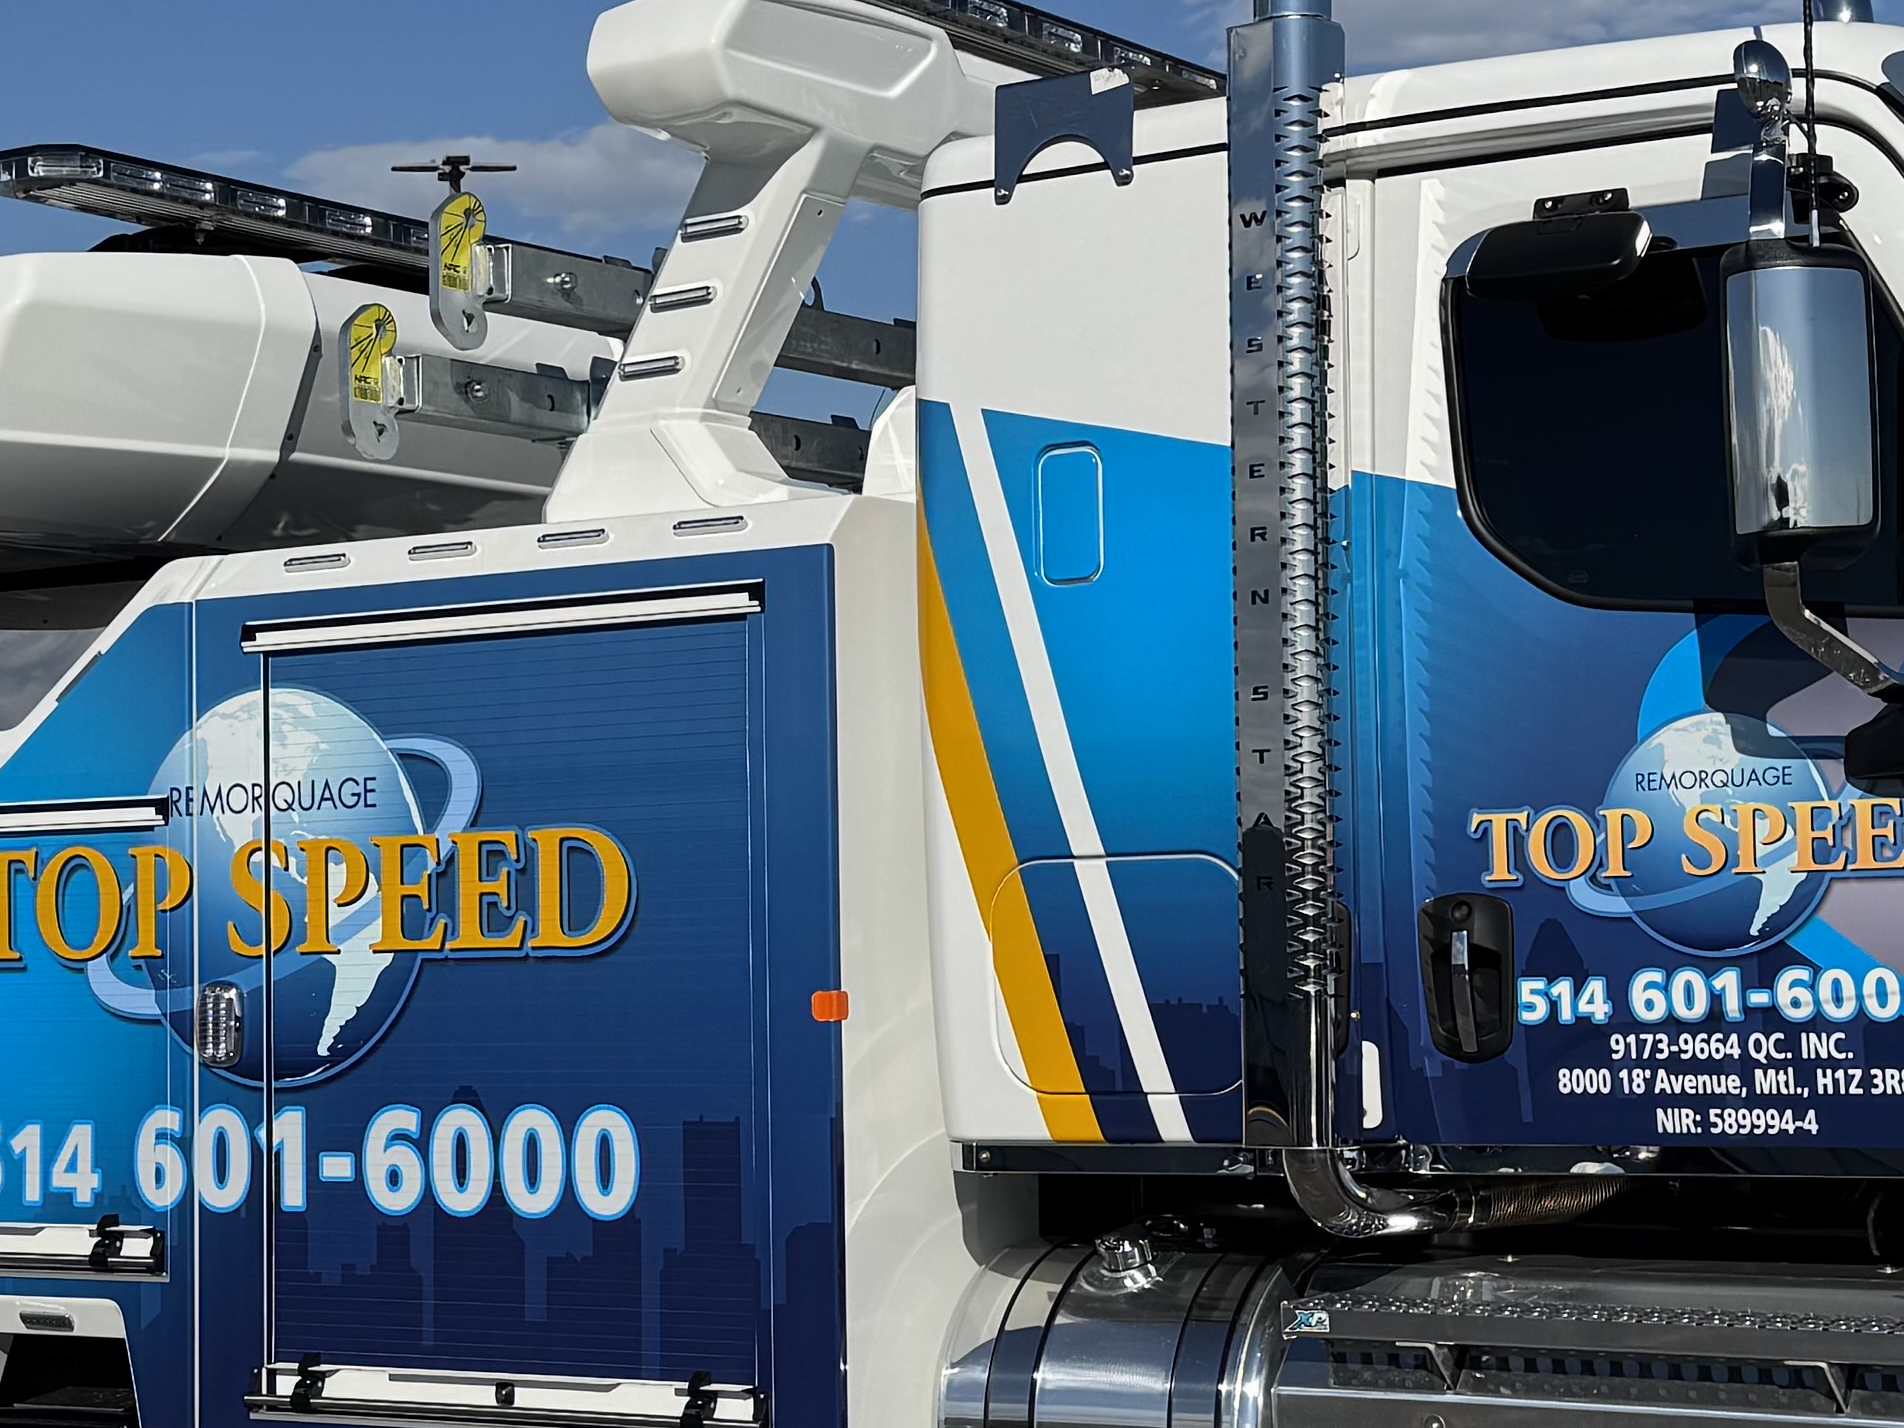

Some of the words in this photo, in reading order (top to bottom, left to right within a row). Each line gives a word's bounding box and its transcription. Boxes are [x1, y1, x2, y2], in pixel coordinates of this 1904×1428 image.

[1240, 210, 1270, 606] WESTERN
[169, 777, 378, 817] REMORQUAGE
[1250, 685, 1274, 892] STAR
[1635, 766, 1793, 793] REMORQUAGE
[1471, 809, 1653, 882] TOP
[226, 828, 633, 959] SPEED
[1517, 976, 1609, 1024] 514
[1610, 1032, 1741, 1060] 9173-9664
[1748, 1032, 1793, 1061] QC.
[1801, 1032, 1854, 1059] INC.
[1558, 1068, 1611, 1094] 8000
[1655, 1070, 1748, 1099] Avenue,
[1754, 1067, 1809, 1099] Mtl.,
[1817, 1068, 1864, 1095] H1Z
[1656, 1108, 1702, 1134] NIR:
[1709, 1108, 1819, 1136] 589994-4
[133, 1103, 641, 1220] 601-6000
